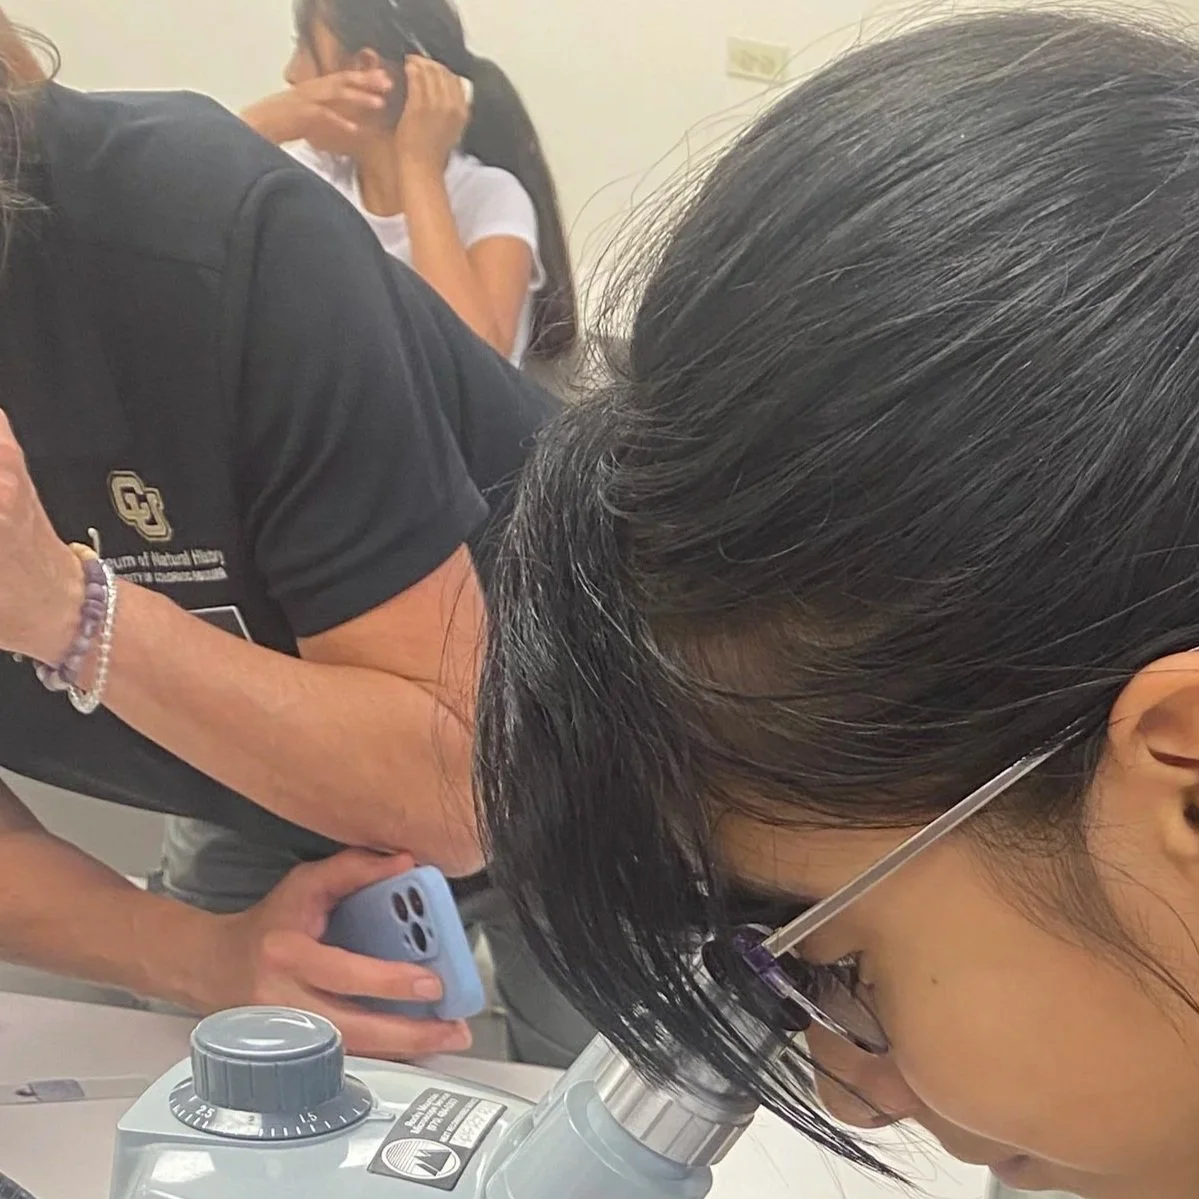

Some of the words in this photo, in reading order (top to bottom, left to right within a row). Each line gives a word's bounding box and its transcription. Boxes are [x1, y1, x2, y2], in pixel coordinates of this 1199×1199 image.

[107, 470, 173, 541] CU
[137, 551, 150, 567] of
[151, 550, 191, 566] Natural
[191, 548, 225, 567] History
[195, 1105, 215, 1118] 2.5
[299, 1112, 318, 1124] 1.5
